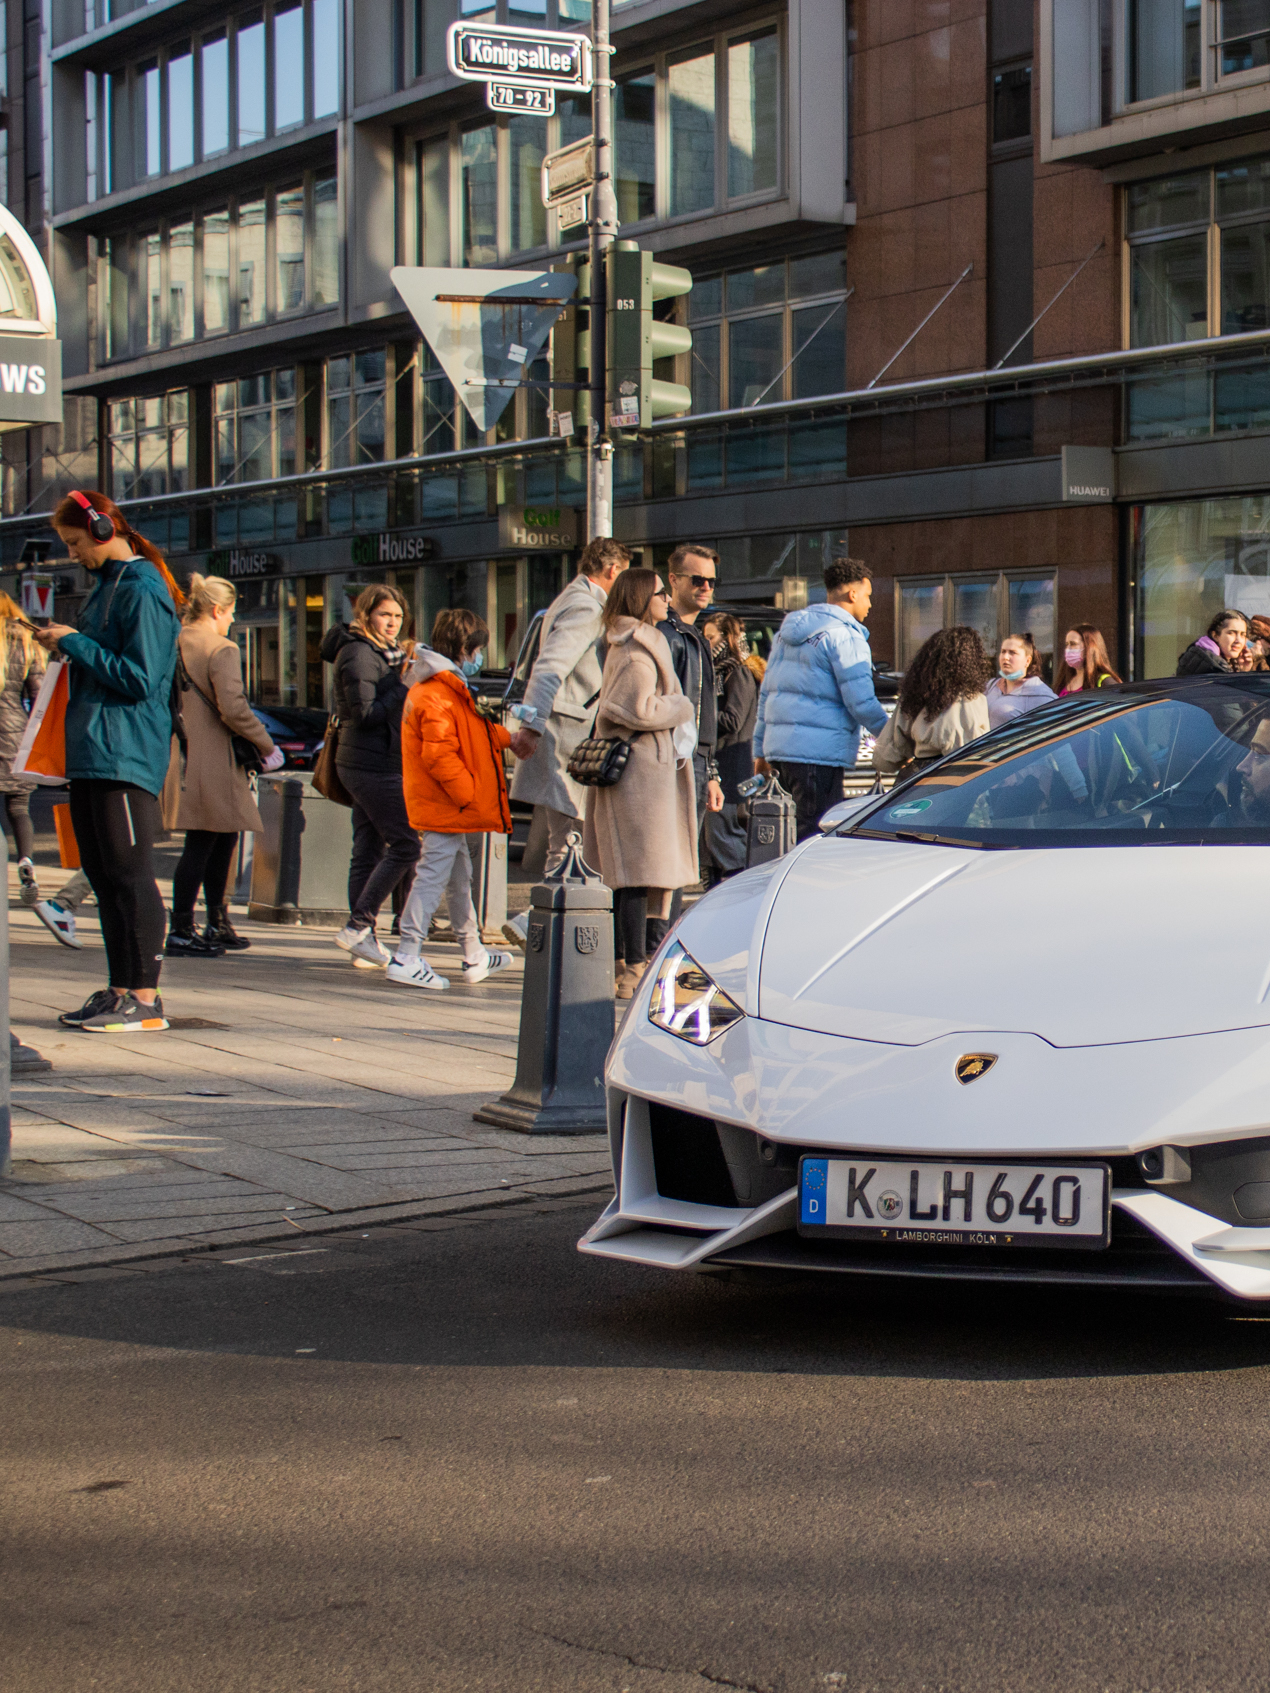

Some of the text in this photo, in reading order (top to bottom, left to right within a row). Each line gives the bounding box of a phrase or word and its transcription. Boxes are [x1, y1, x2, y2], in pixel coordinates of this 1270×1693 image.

[469, 37, 571, 72] Königsallee
[617, 299, 635, 310] 053
[1069, 485, 1110, 497] HUAWEI
[523, 508, 561, 528] Golf
[511, 526, 571, 547] House
[847, 1167, 877, 1219] K
[986, 1172, 1082, 1227] 640
[809, 1199, 819, 1213] D
[896, 1230, 998, 1245] LAMBORGHINI KÖLN
